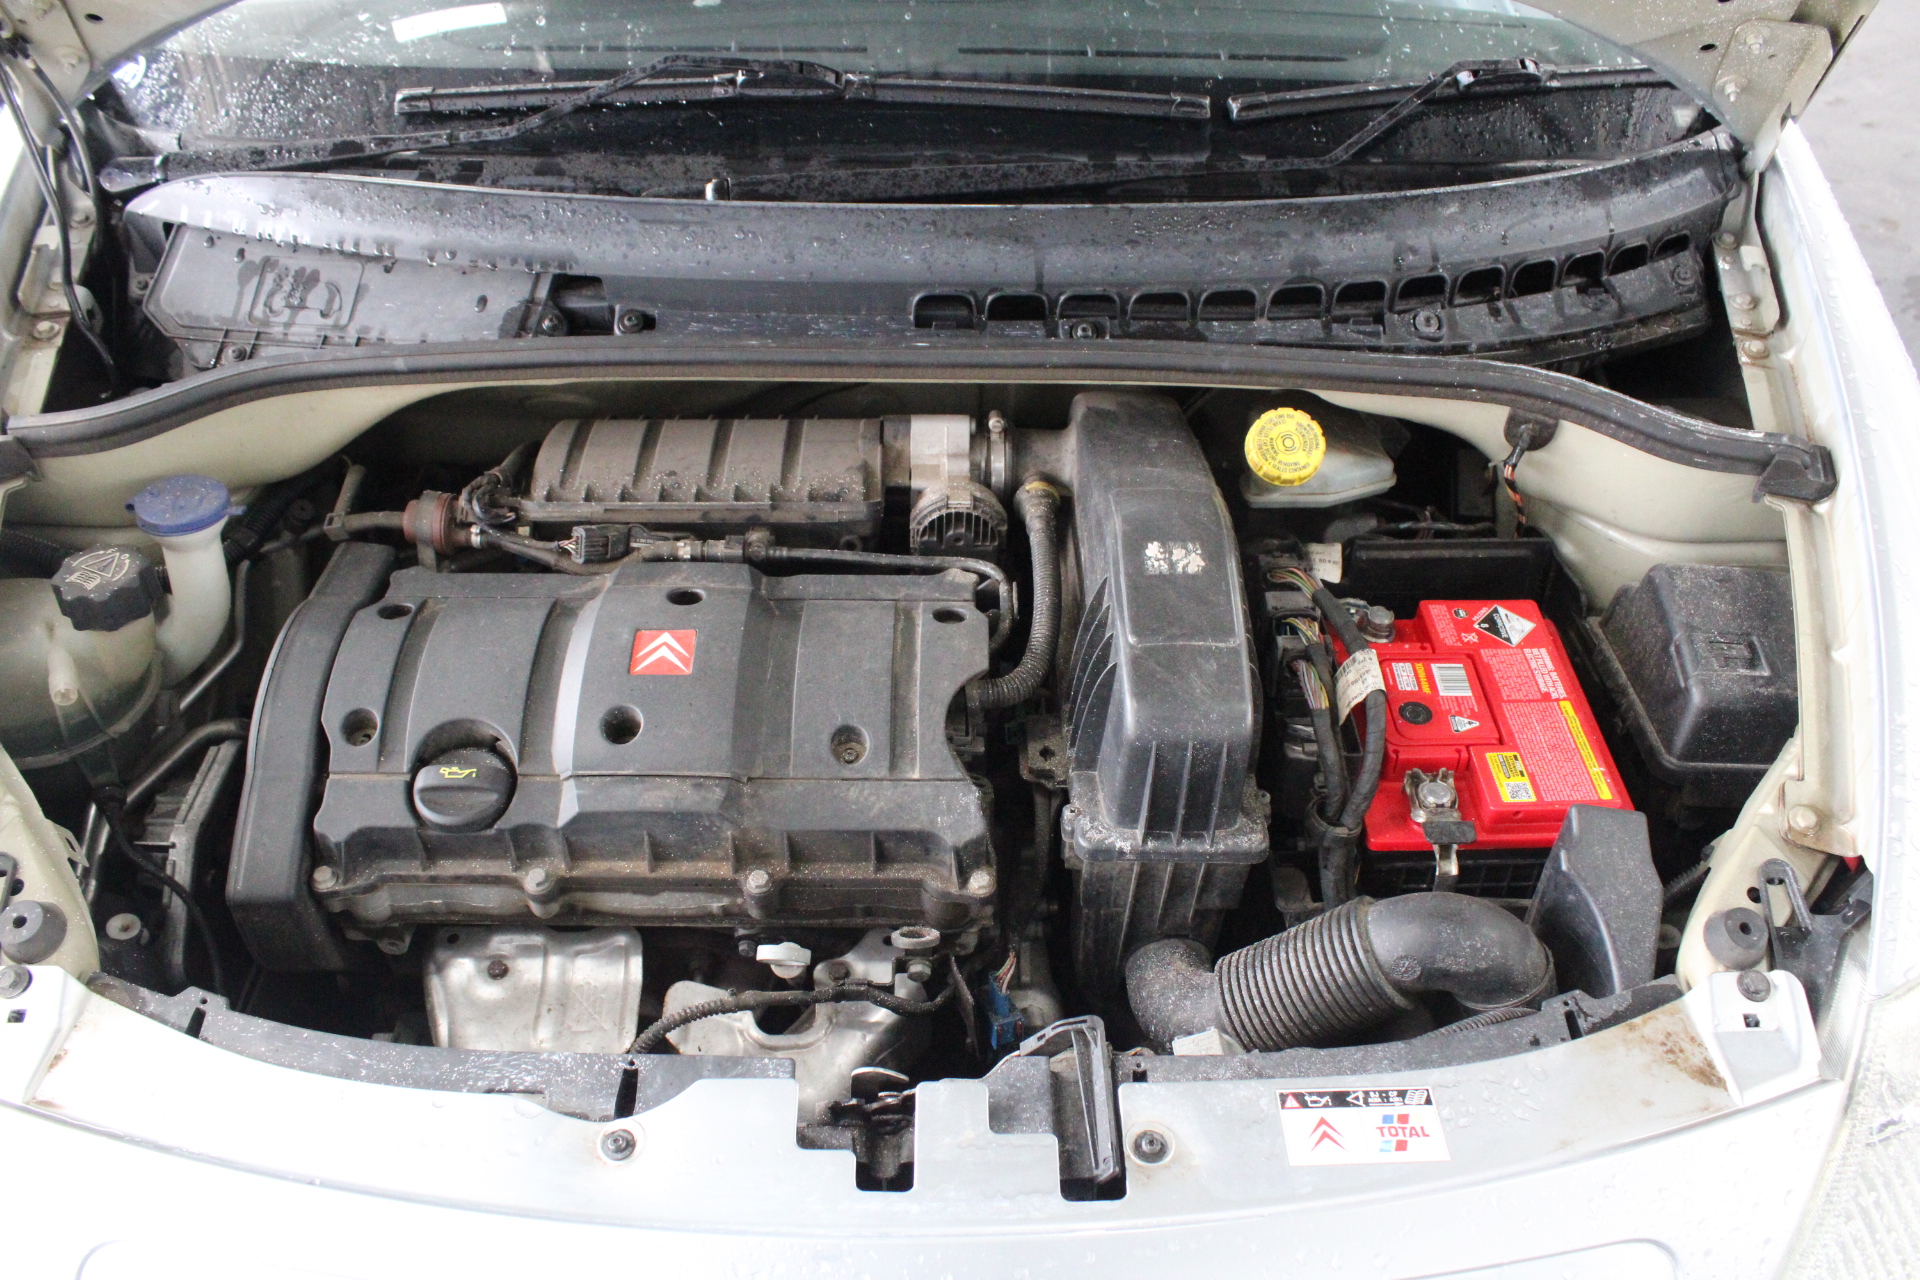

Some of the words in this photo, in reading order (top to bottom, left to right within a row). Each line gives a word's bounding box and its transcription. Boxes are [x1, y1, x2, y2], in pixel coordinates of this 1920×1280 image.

[1259, 451, 1269, 464] FROM
[1271, 463, 1287, 473] SEALED
[1289, 461, 1311, 474] CONTAINER
[1277, 460, 1301, 468] REMOVING
[1493, 613, 1508, 639] CORROSIVE
[1523, 649, 1540, 670] ELECTRIC
[1531, 648, 1543, 659] WET
[1534, 658, 1549, 674] FILLED
[1415, 663, 1432, 694] XDIN44MF
[1541, 674, 1555, 687] WITH
[1375, 1126, 1430, 1138] TOTAL
